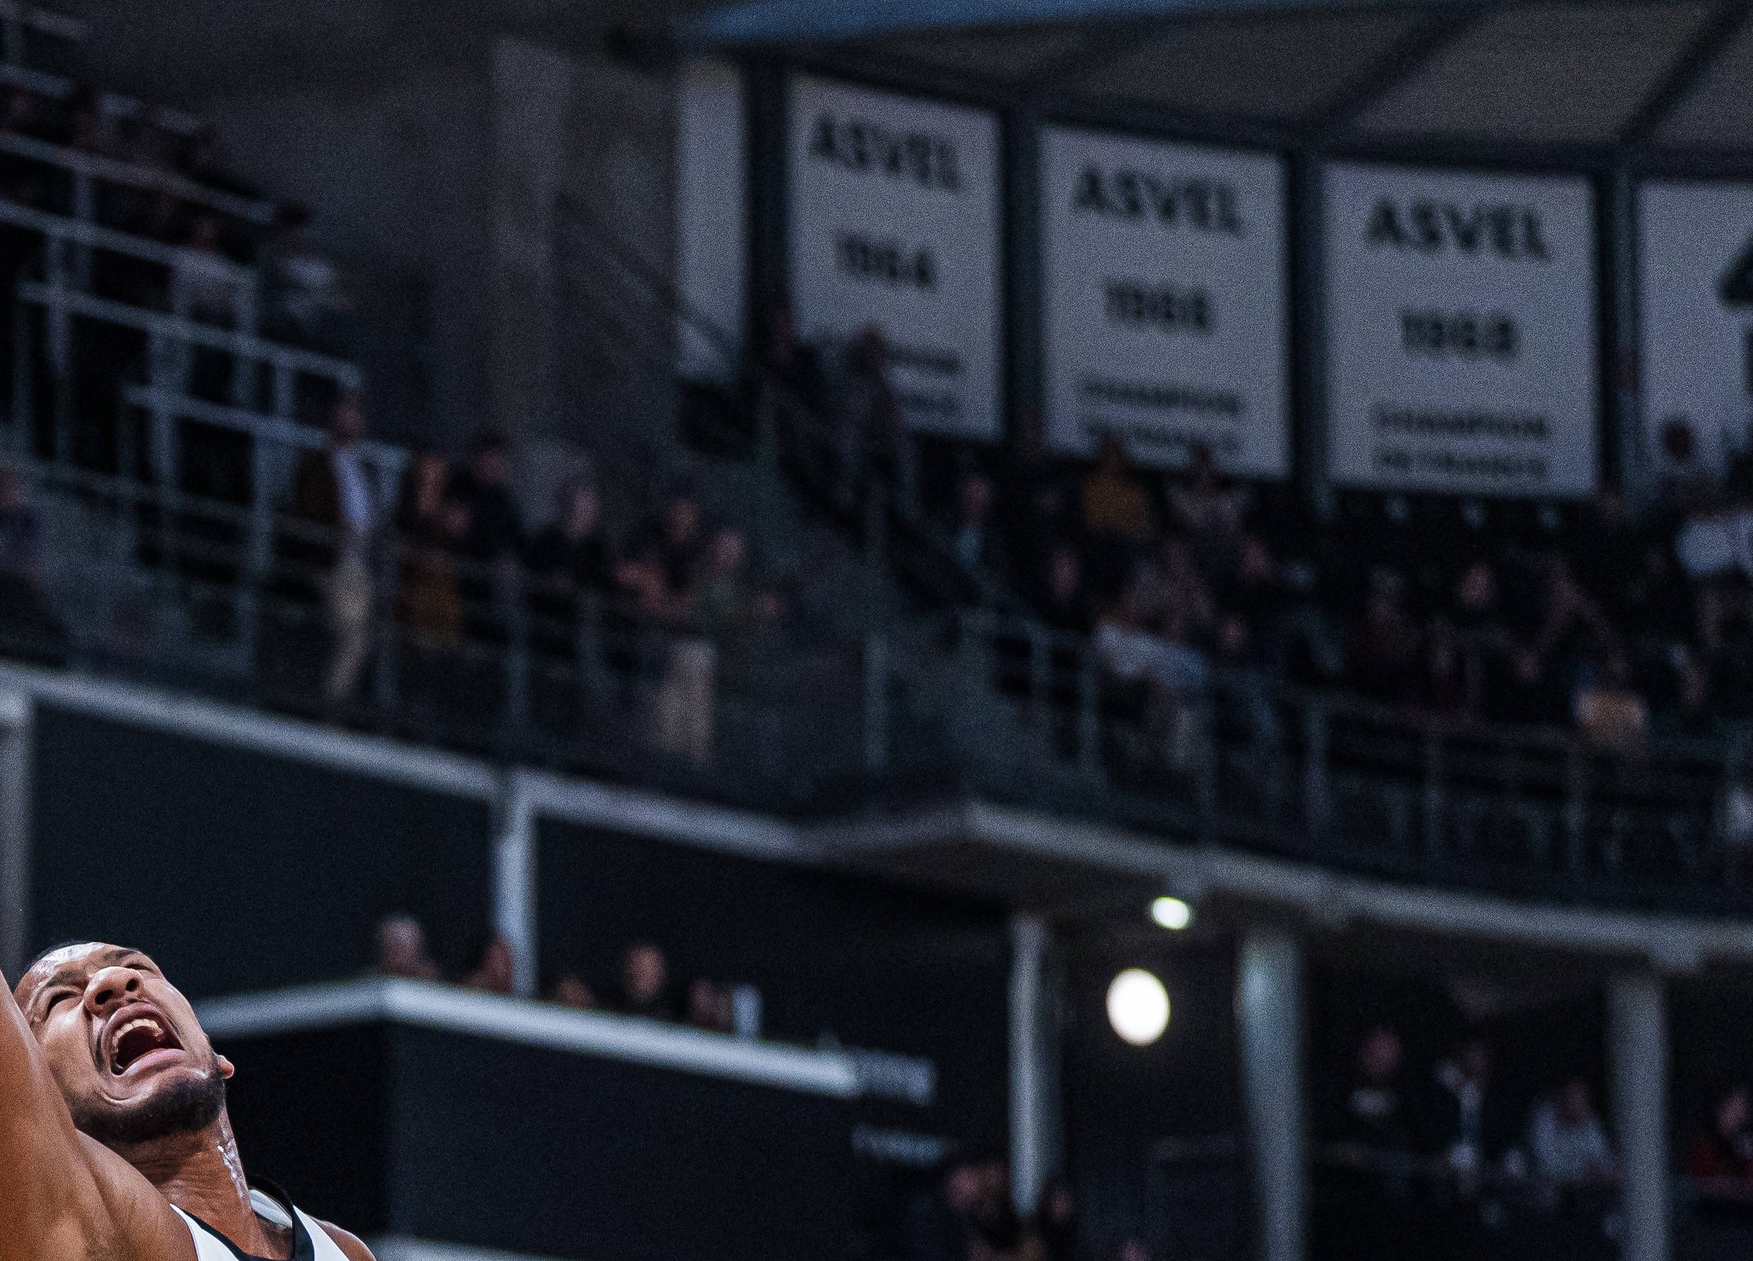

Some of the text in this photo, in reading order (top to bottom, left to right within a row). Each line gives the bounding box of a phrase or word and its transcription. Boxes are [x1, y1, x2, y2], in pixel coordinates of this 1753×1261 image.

[810, 112, 964, 193] ASVEL
[1073, 167, 1242, 237] ASVEL
[1367, 198, 1549, 260] ASVEL
